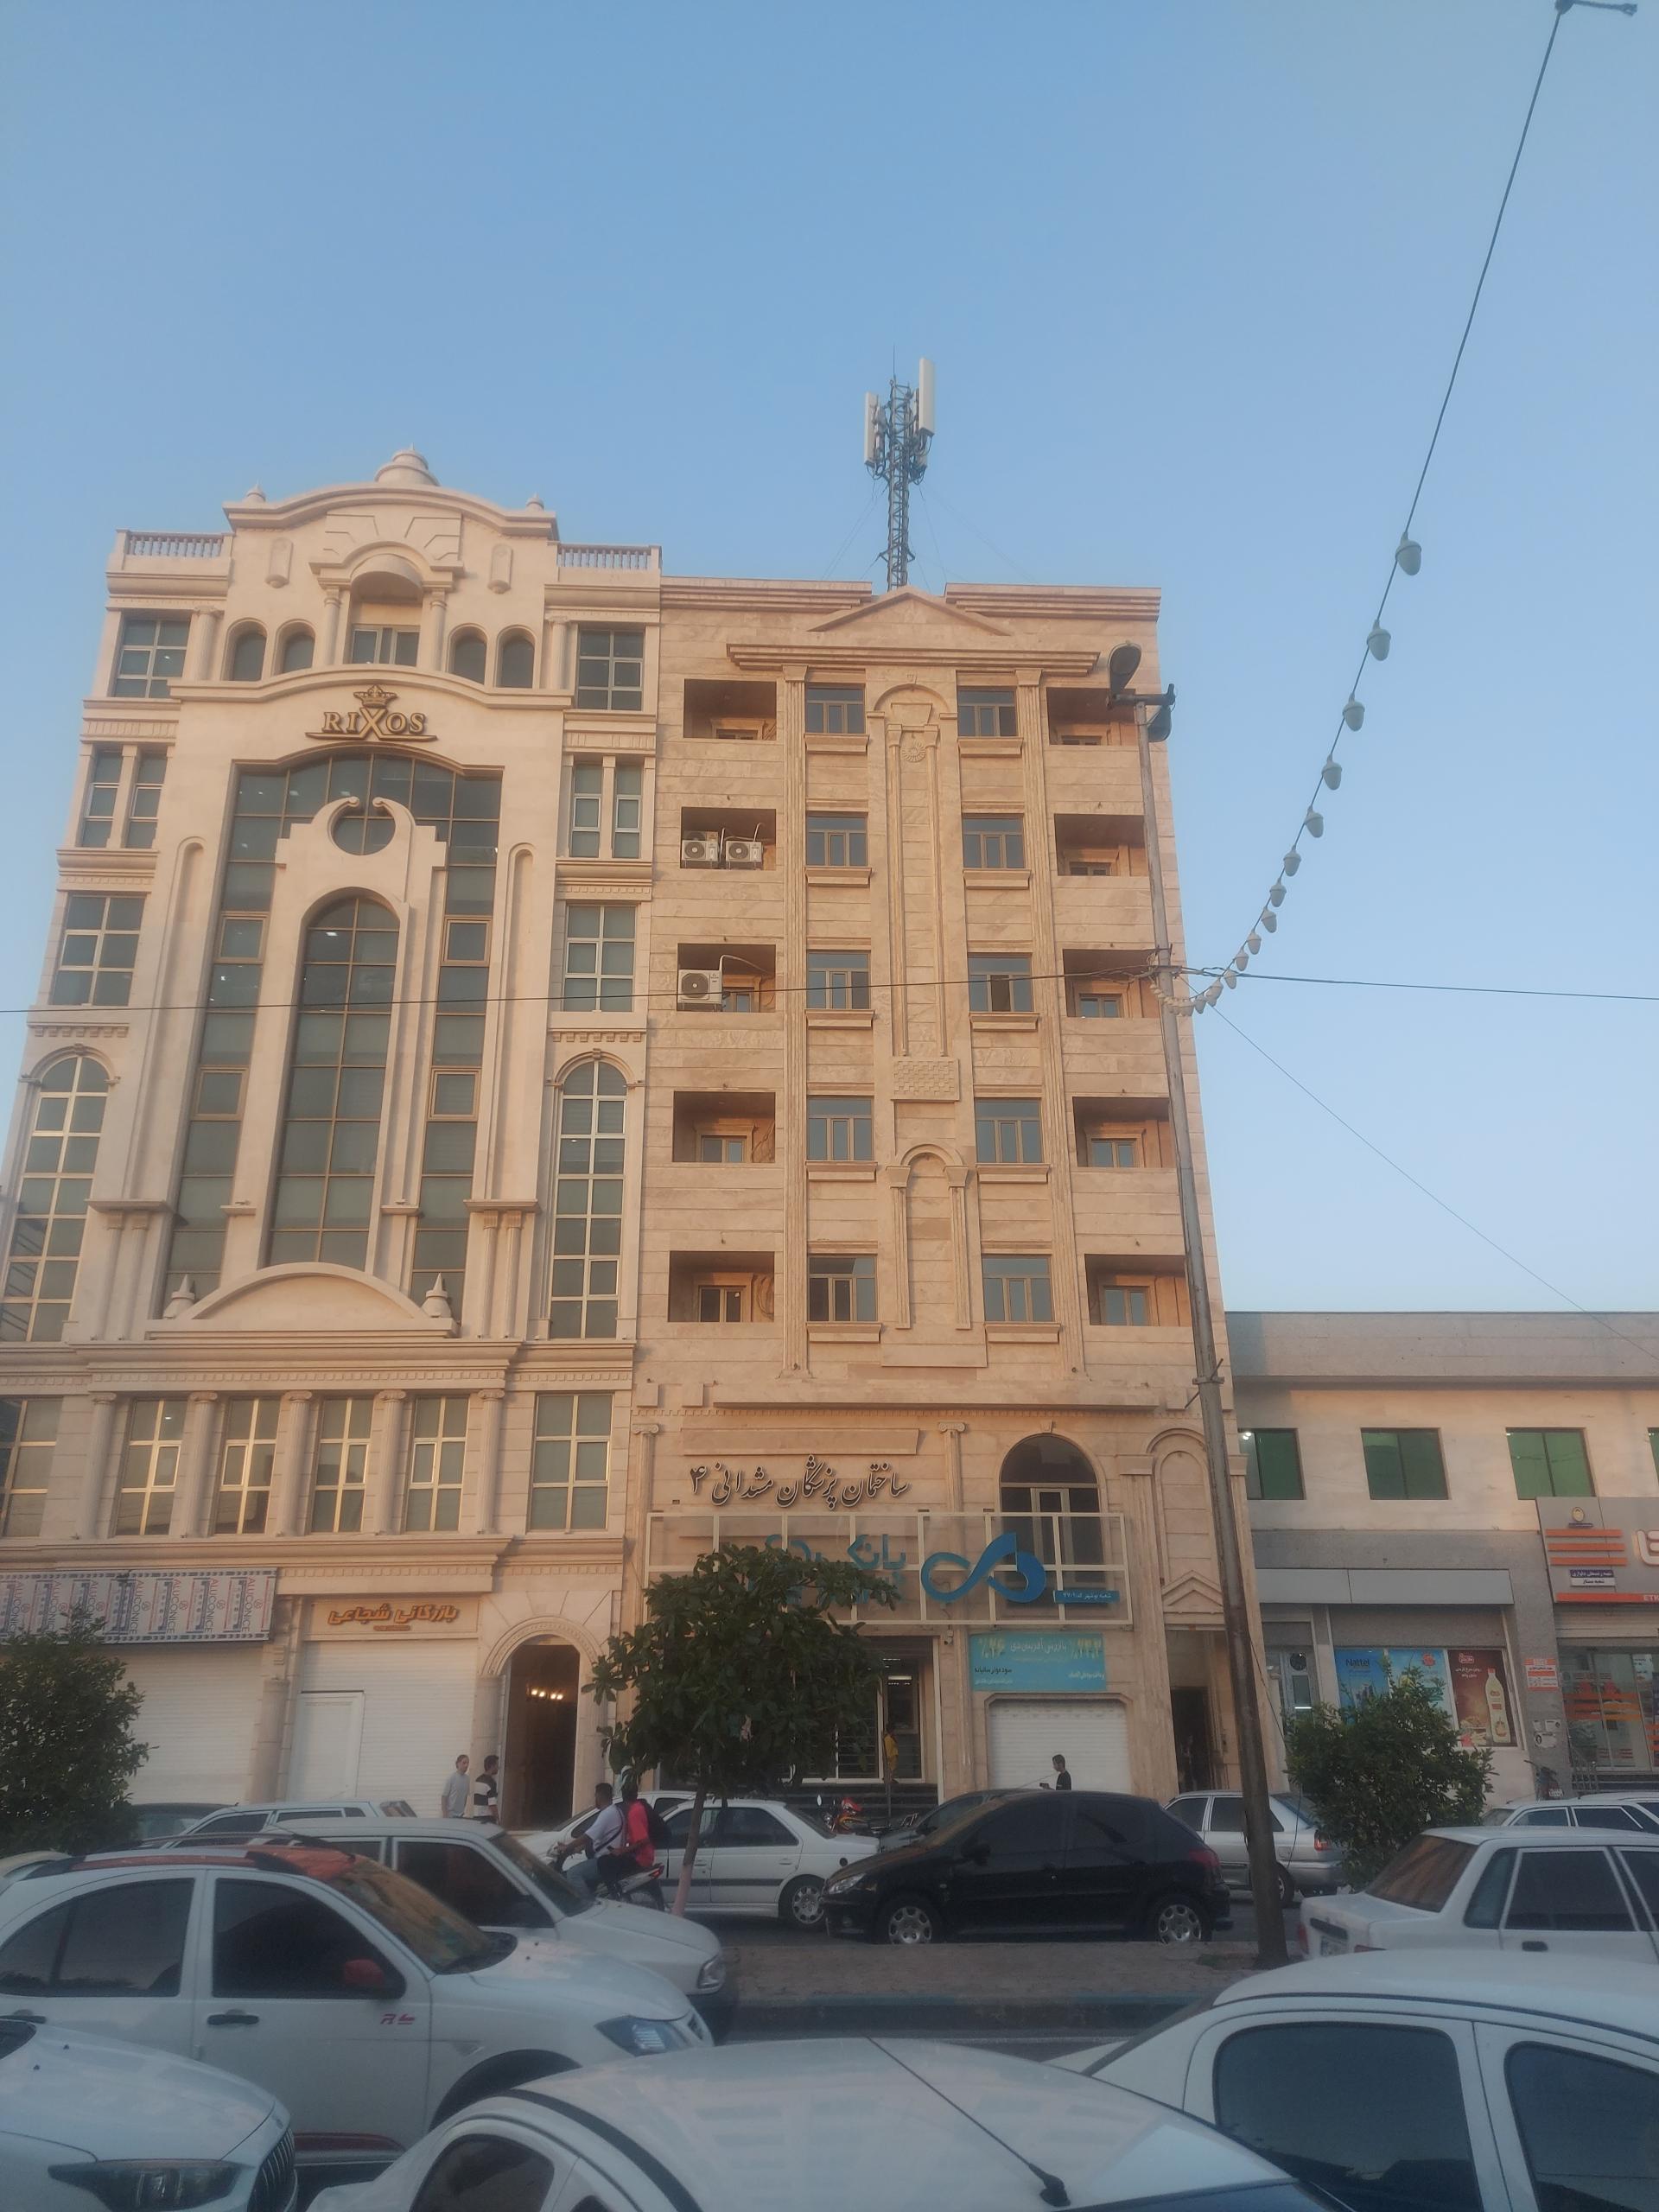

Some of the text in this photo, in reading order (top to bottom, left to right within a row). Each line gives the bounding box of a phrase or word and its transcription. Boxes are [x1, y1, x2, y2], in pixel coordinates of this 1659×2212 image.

[321, 707, 426, 739] RIXOS
[690, 1465, 707, 1495] ۴
[776, 1454, 837, 1510] پزشکان
[841, 1463, 908, 1507] ساختمان
[9, 1580, 24, 1631] ALUCONIC
[47, 1580, 62, 1631] ALUCONIC
[130, 1580, 145, 1635] ALUCONICE
[167, 1580, 182, 1634] ALUCONICE
[204, 1579, 219, 1633] ALUCONICE
[241, 1578, 257, 1632] ALUCONICE
[327, 1603, 458, 1625] بازرگانی شجاعی
